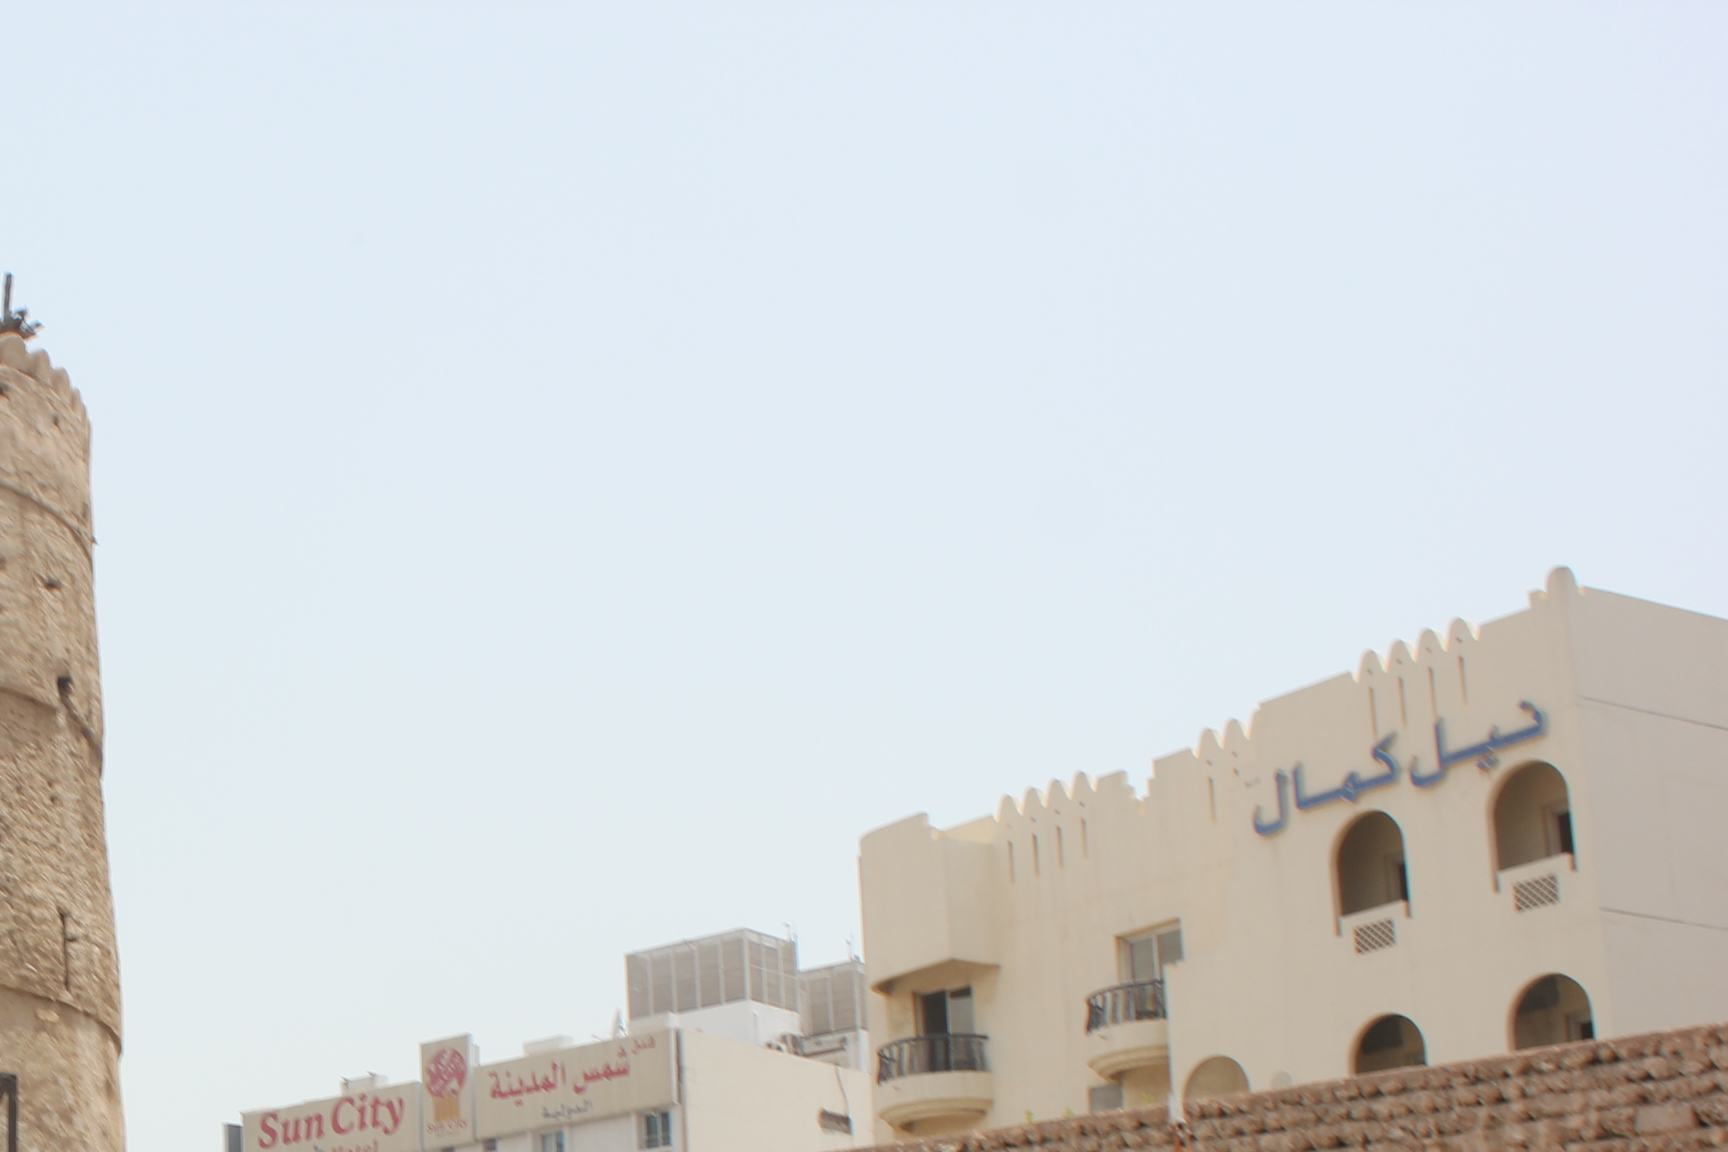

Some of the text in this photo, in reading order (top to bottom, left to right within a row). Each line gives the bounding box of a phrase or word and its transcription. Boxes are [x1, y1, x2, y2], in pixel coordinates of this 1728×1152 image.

[1253, 730, 1399, 838] كمال
[488, 1046, 631, 1108] شمس المدينة
[258, 1093, 406, 1151] Sun City
